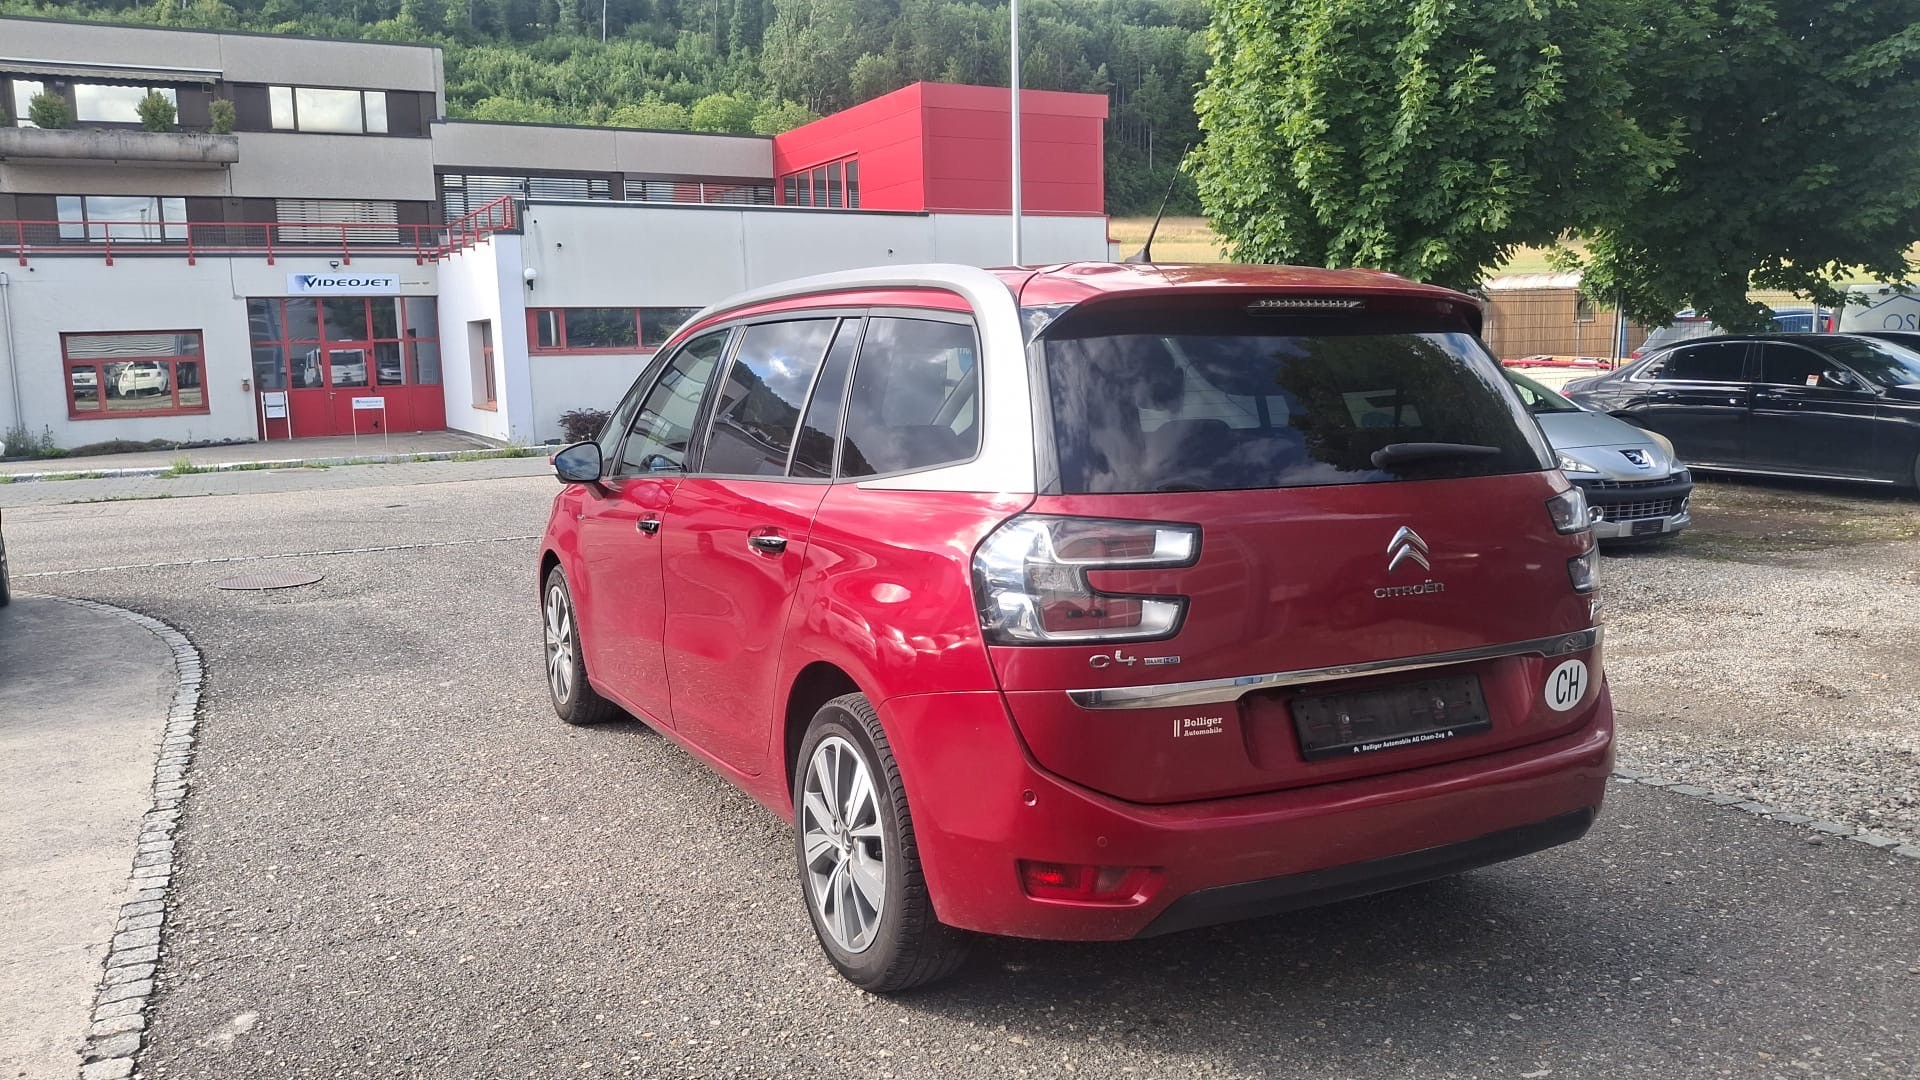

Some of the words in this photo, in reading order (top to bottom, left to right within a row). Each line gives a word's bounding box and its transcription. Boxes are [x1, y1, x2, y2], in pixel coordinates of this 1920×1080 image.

[303, 276, 392, 288] VIDEOJET
[1374, 579, 1445, 598] CITROËN
[1089, 650, 1137, 668] C4
[1555, 665, 1580, 704] CH
[1183, 716, 1223, 728] Bolliger
[1183, 727, 1223, 737] Automobile
[1412, 735, 1420, 743] AG
